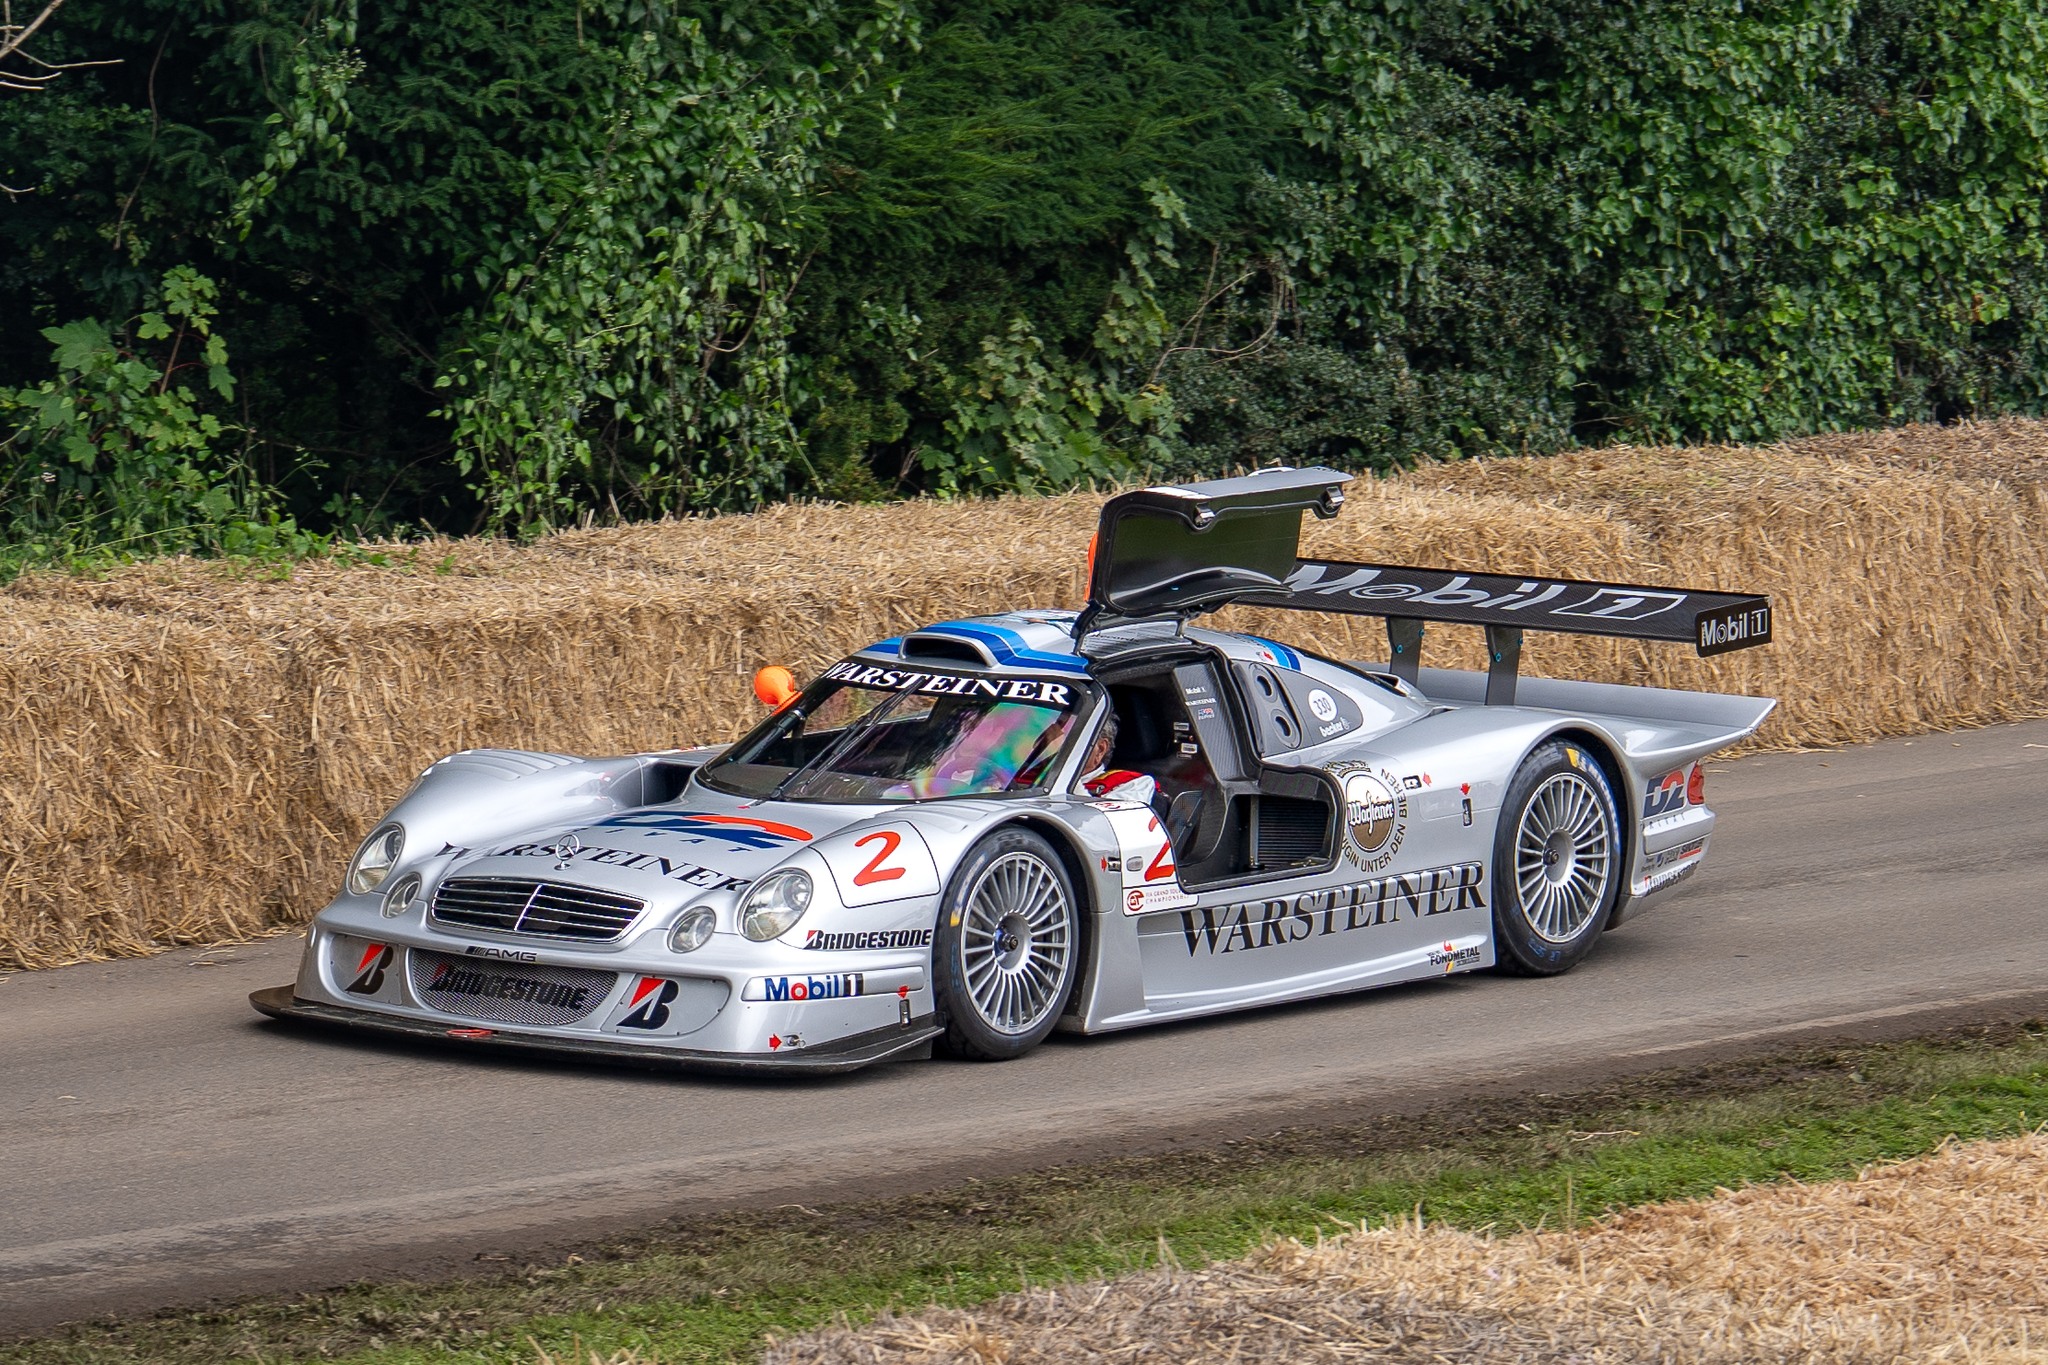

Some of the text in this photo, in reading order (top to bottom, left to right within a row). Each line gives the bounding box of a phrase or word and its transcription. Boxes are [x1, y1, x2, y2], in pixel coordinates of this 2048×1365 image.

[1283, 564, 1567, 612] Mobil
[1701, 611, 1748, 647] Mobil
[820, 662, 1070, 705] WARSTEINER
[1319, 721, 1343, 738] becker
[1380, 768, 1409, 819] BIEREN
[1643, 769, 1685, 819] D2
[1389, 823, 1407, 856] DEN
[853, 831, 906, 887] 2
[1361, 851, 1393, 873] UNTER
[1179, 863, 1488, 958] WARSTEINER
[482, 948, 537, 962] AMG
[803, 929, 932, 950] BRIDGESTONE
[1430, 946, 1481, 966] FONDMETAL
[427, 961, 590, 1011] BRIDGESTONE
[764, 974, 839, 1000] Mobil
